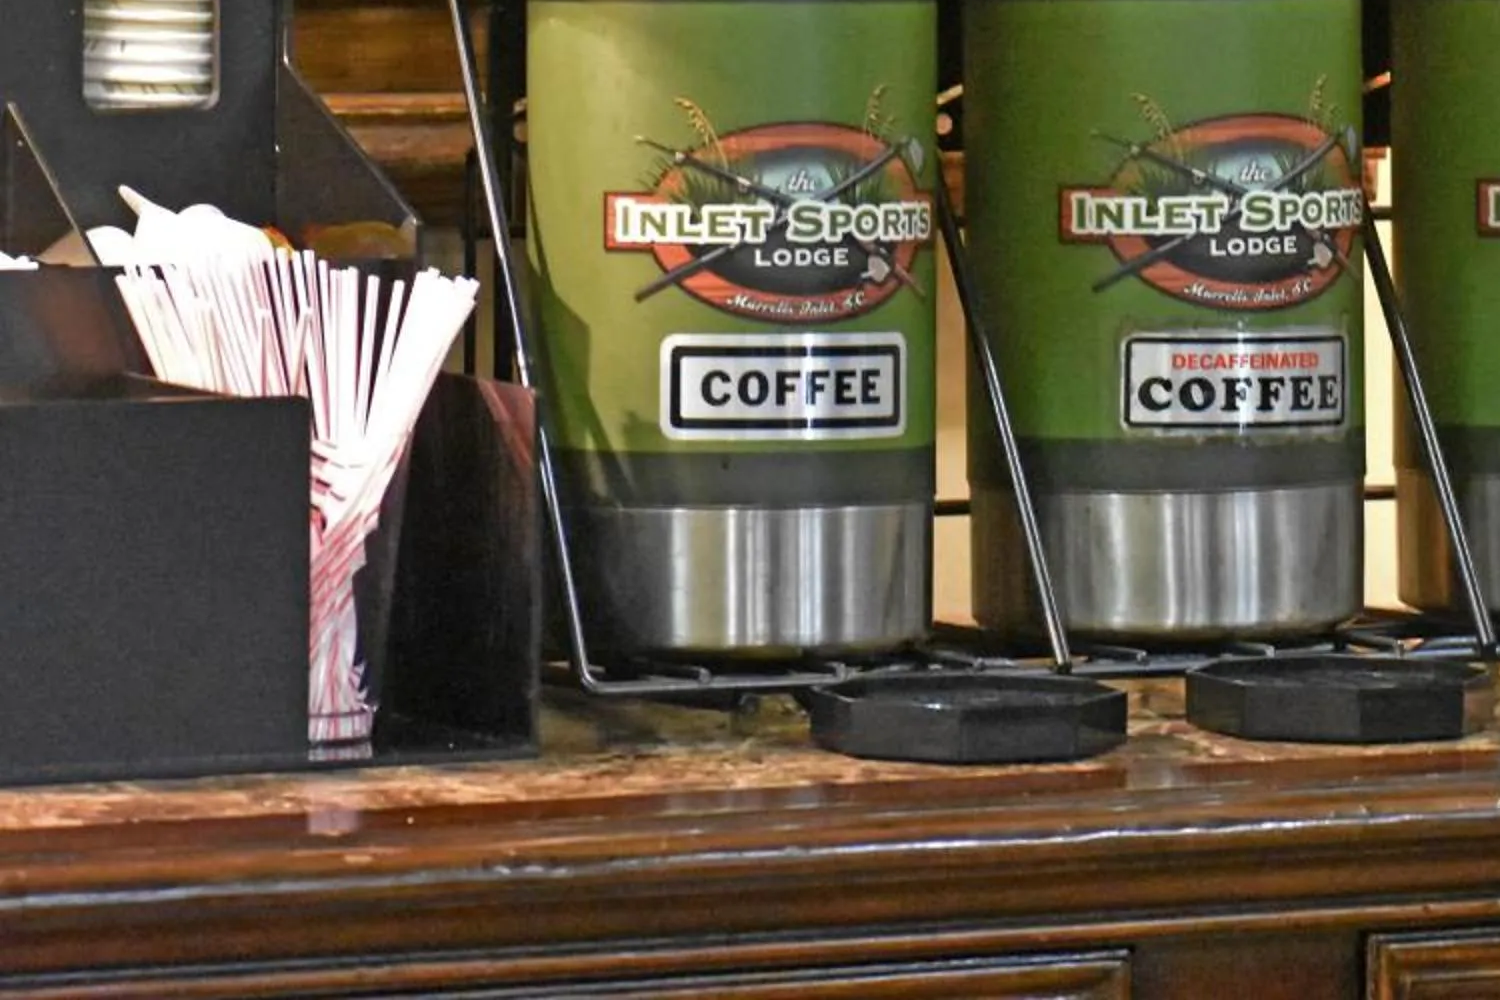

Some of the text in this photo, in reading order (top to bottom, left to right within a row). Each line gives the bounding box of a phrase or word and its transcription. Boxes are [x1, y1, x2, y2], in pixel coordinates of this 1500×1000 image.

[615, 198, 931, 244] INLET SPORTS
[1071, 188, 1363, 235] INLET SPORTS
[755, 248, 849, 267] LODGE
[1210, 235, 1298, 257] LODGE
[1172, 351, 1320, 371] DECAFFEINATED
[700, 368, 881, 407] COFFEE
[1138, 374, 1339, 412] COFFEE
